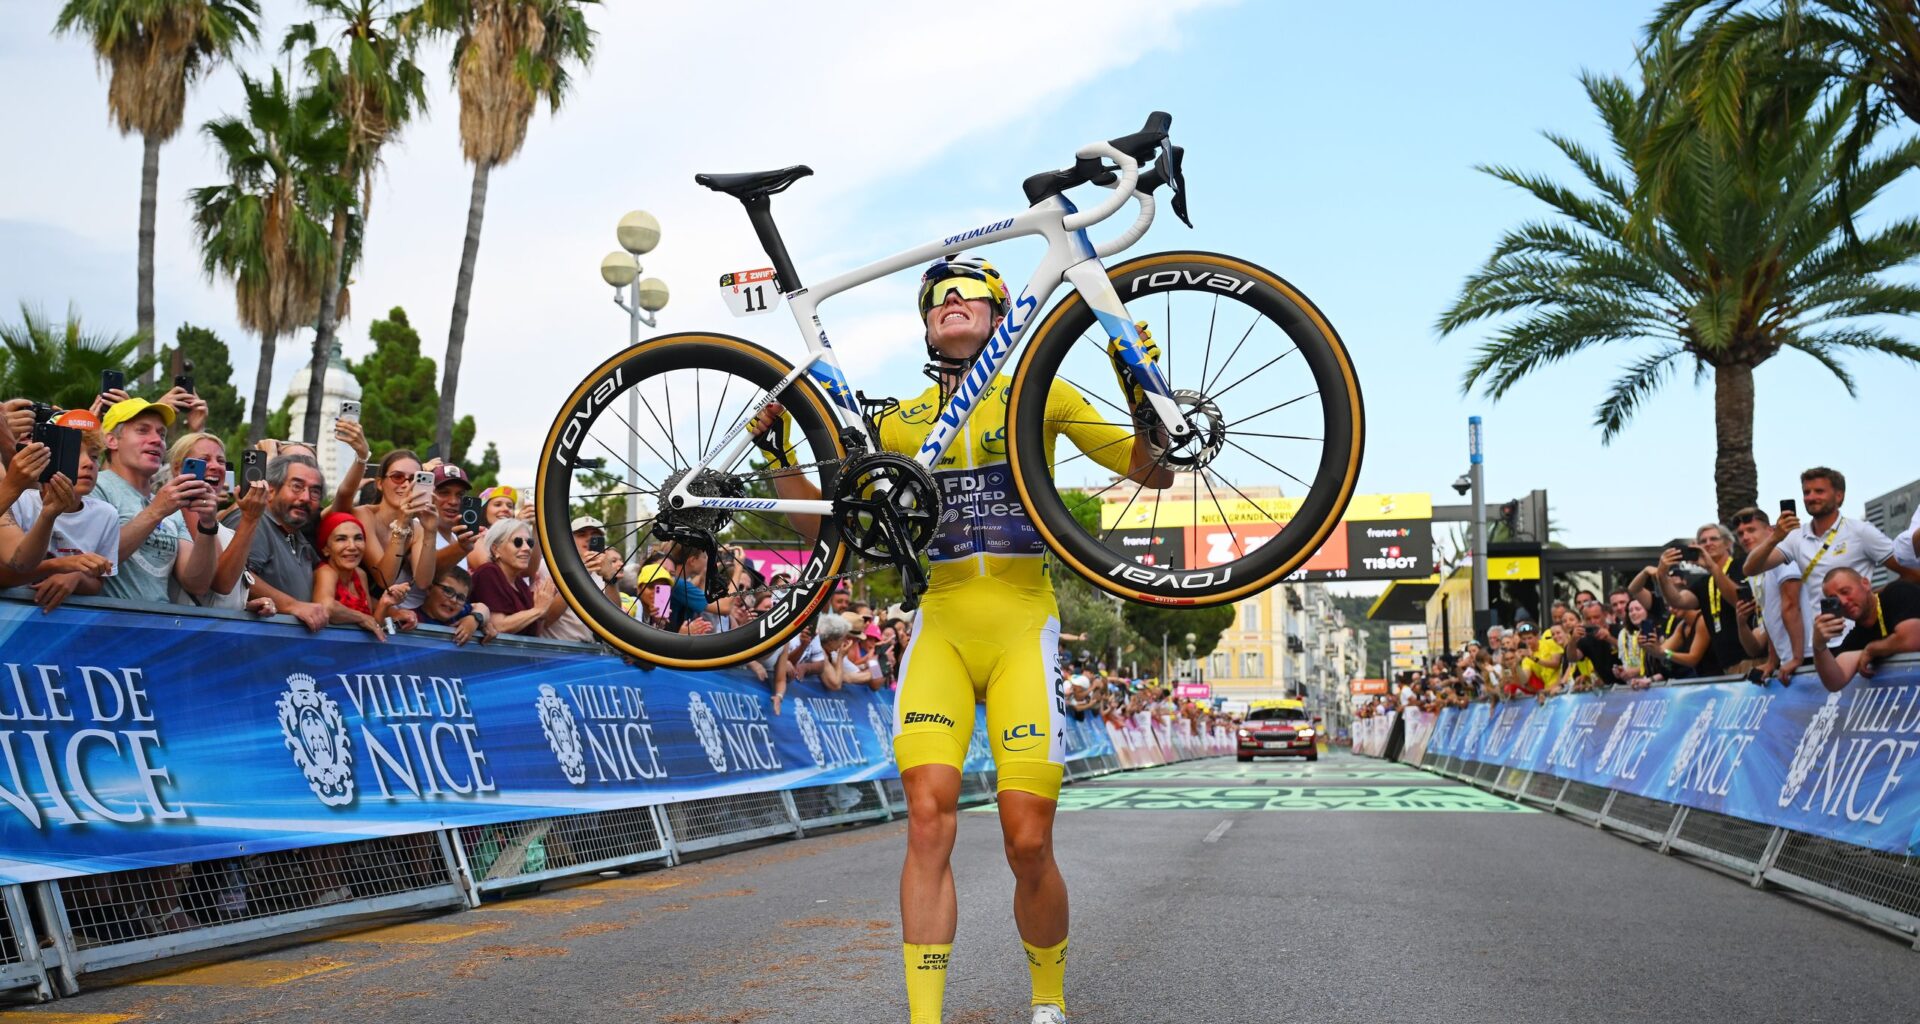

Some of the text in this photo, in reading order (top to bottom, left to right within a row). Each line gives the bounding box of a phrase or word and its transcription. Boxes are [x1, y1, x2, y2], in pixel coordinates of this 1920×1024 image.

[943, 218, 1015, 246] SPECIALIZED
[743, 285, 767, 312] 11
[1131, 270, 1256, 295] roval
[921, 284, 1038, 467] S-WORKS
[753, 377, 789, 412] SHIMANO
[901, 403, 933, 419] LCL
[556, 367, 623, 467] roval
[943, 474, 986, 493] FDJ
[946, 491, 1005, 505] UNITED
[700, 499, 778, 510] SPECIALIZED
[1108, 562, 1232, 590] roval
[1362, 556, 1418, 570] TISSOT
[759, 540, 830, 639] roval
[76, 665, 155, 722] DE
[336, 674, 473, 718] VILLE DE
[566, 684, 649, 720] VILLE DE
[707, 691, 767, 720] VILLE DE
[1843, 686, 1908, 732] VILLE
[904, 711, 955, 728] Santini
[1004, 723, 1045, 742] LCL
[361, 722, 495, 799] NICE
[584, 723, 668, 782] NICE
[722, 723, 782, 771] NICE
[819, 724, 867, 766] NICE
[1605, 730, 1656, 780] NICE
[1682, 734, 1755, 796] NICE
[1802, 736, 1919, 825] NICE
